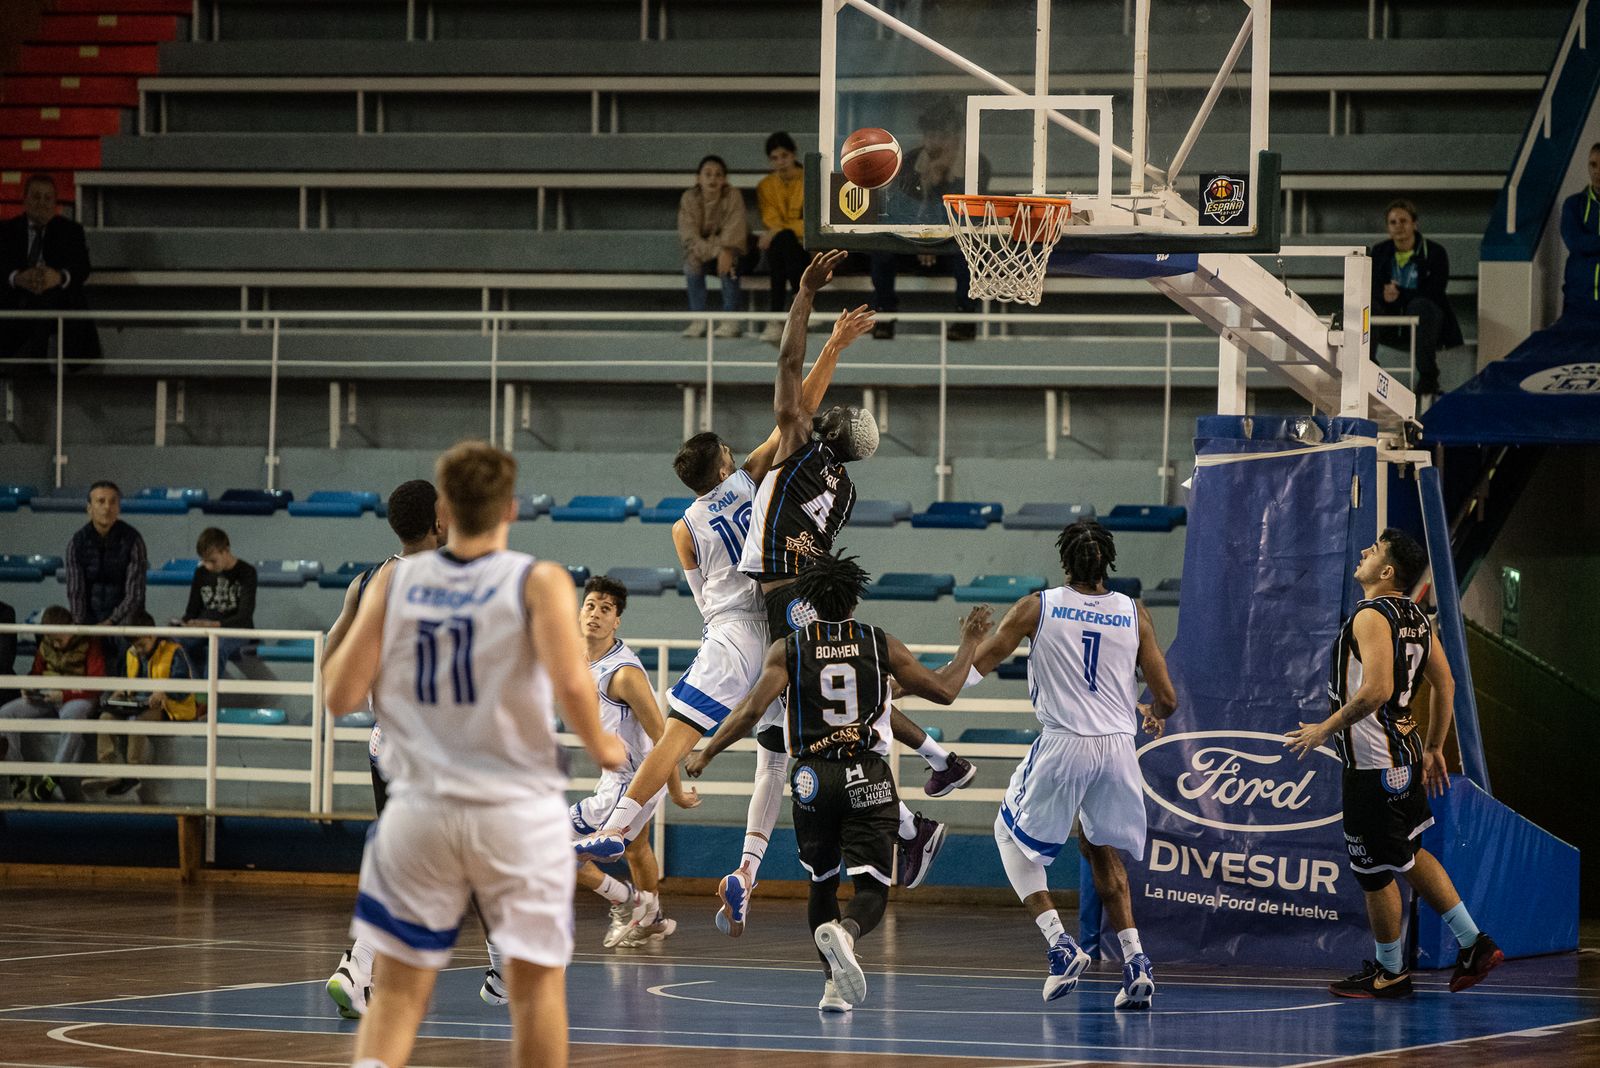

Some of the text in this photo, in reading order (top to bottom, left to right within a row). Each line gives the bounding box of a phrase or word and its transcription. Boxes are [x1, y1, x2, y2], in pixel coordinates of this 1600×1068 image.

[1207, 200, 1243, 212] ESPAÑA
[708, 490, 738, 512] RAÚL
[801, 490, 836, 534] 4
[1051, 606, 1131, 628] NICKERSON
[416, 617, 475, 702] 11
[816, 644, 859, 659] BOAHEN
[1082, 630, 1101, 691] 1
[820, 663, 858, 726] 9
[848, 779, 892, 798] DIPUTACIÓN
[1177, 747, 1316, 810] Ford
[865, 790, 892, 801] HUELVA
[1348, 843, 1366, 856] ORO
[1148, 838, 1340, 894] DIVESUR
[1144, 883, 1339, 921] La nueva Ford de Huelva
